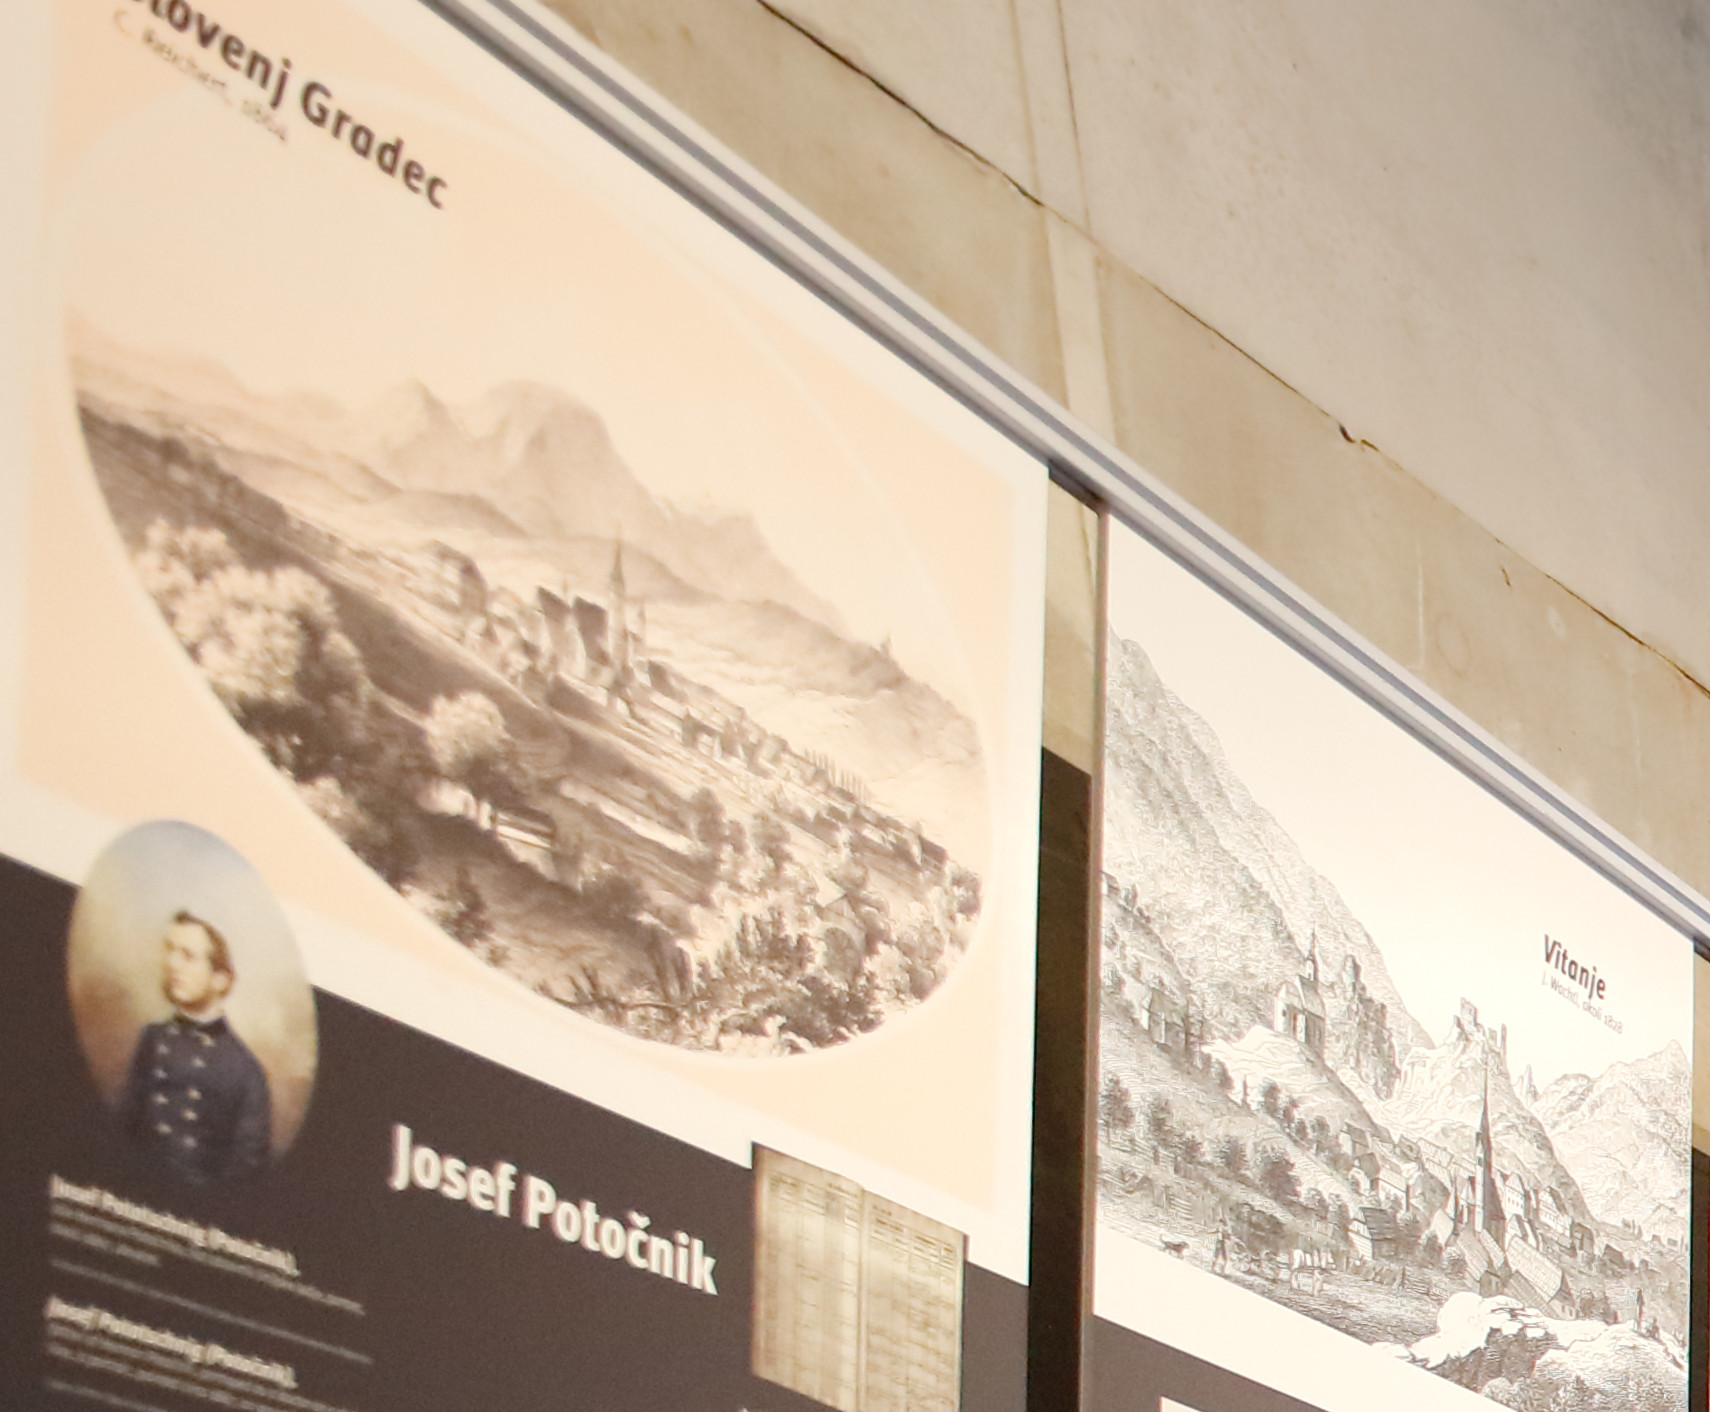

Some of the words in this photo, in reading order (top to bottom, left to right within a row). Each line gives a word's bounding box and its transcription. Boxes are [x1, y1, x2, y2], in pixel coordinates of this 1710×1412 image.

[300, 80, 448, 210] Gradec
[1545, 934, 1606, 1000] Vitanje
[389, 1123, 518, 1219] Josef
[522, 1174, 719, 1298] Potočnik
